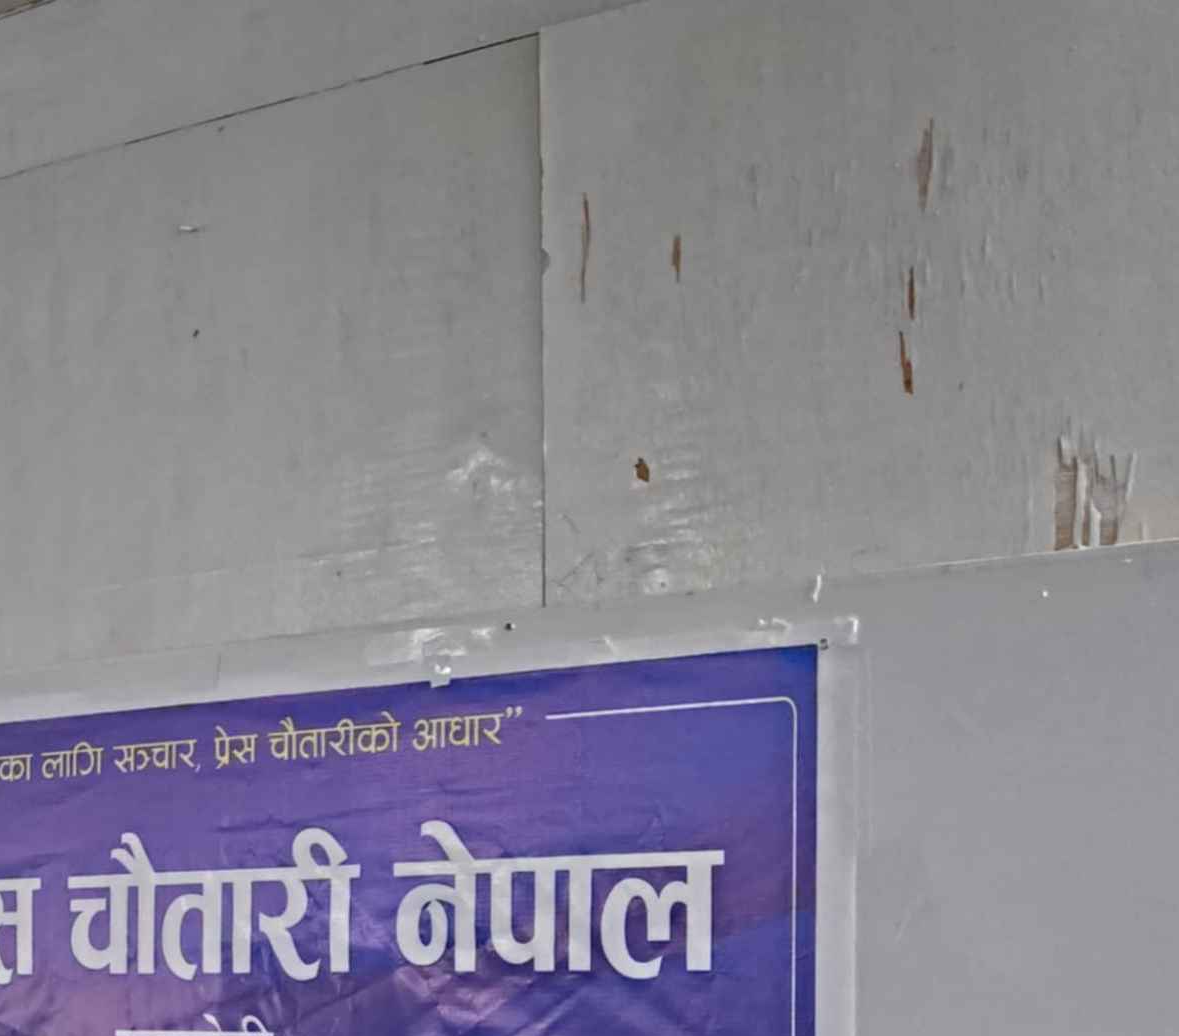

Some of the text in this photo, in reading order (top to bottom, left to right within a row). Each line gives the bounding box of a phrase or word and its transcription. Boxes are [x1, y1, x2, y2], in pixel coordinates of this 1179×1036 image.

[40, 741, 104, 779] लागि
[214, 725, 258, 769] प्रेस
[267, 710, 401, 761] चौतारीको
[411, 705, 523, 751] आधार”
[67, 827, 361, 983] चौतारी
[392, 820, 725, 980] नेपाल
